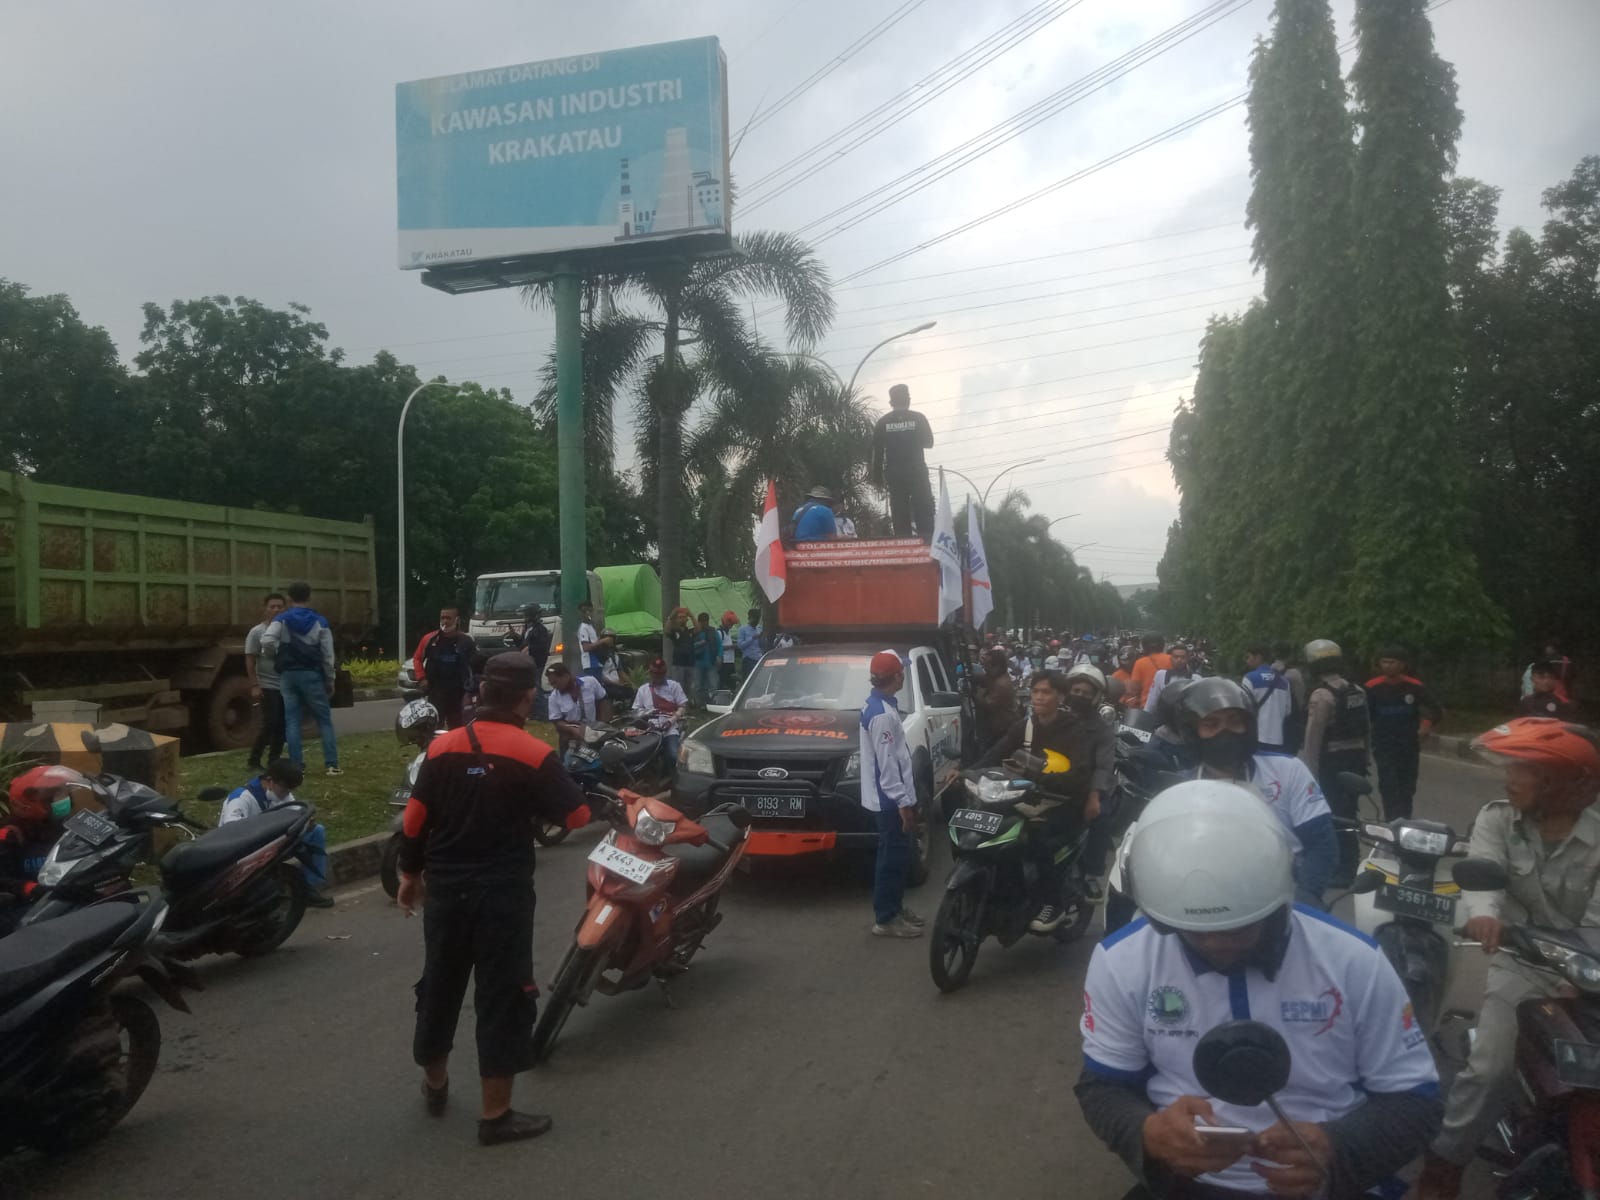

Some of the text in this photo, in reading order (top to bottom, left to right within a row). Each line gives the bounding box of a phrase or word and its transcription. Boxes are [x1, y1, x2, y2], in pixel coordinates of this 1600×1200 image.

[508, 57, 578, 84] DATANG
[582, 55, 600, 71] DI
[431, 77, 683, 136] KAWASAN INDUSTRI
[488, 125, 623, 165] KRAKATAU
[425, 248, 473, 261] KRAKATAU
[720, 727, 849, 740] GARDA METAL
[757, 796, 779, 810] 8193
[789, 797, 802, 810] RM
[598, 846, 606, 855] A
[609, 850, 633, 866] 2443
[1381, 886, 1388, 896] A
[1435, 897, 1450, 911] TU
[1184, 906, 1231, 915] HONDA
